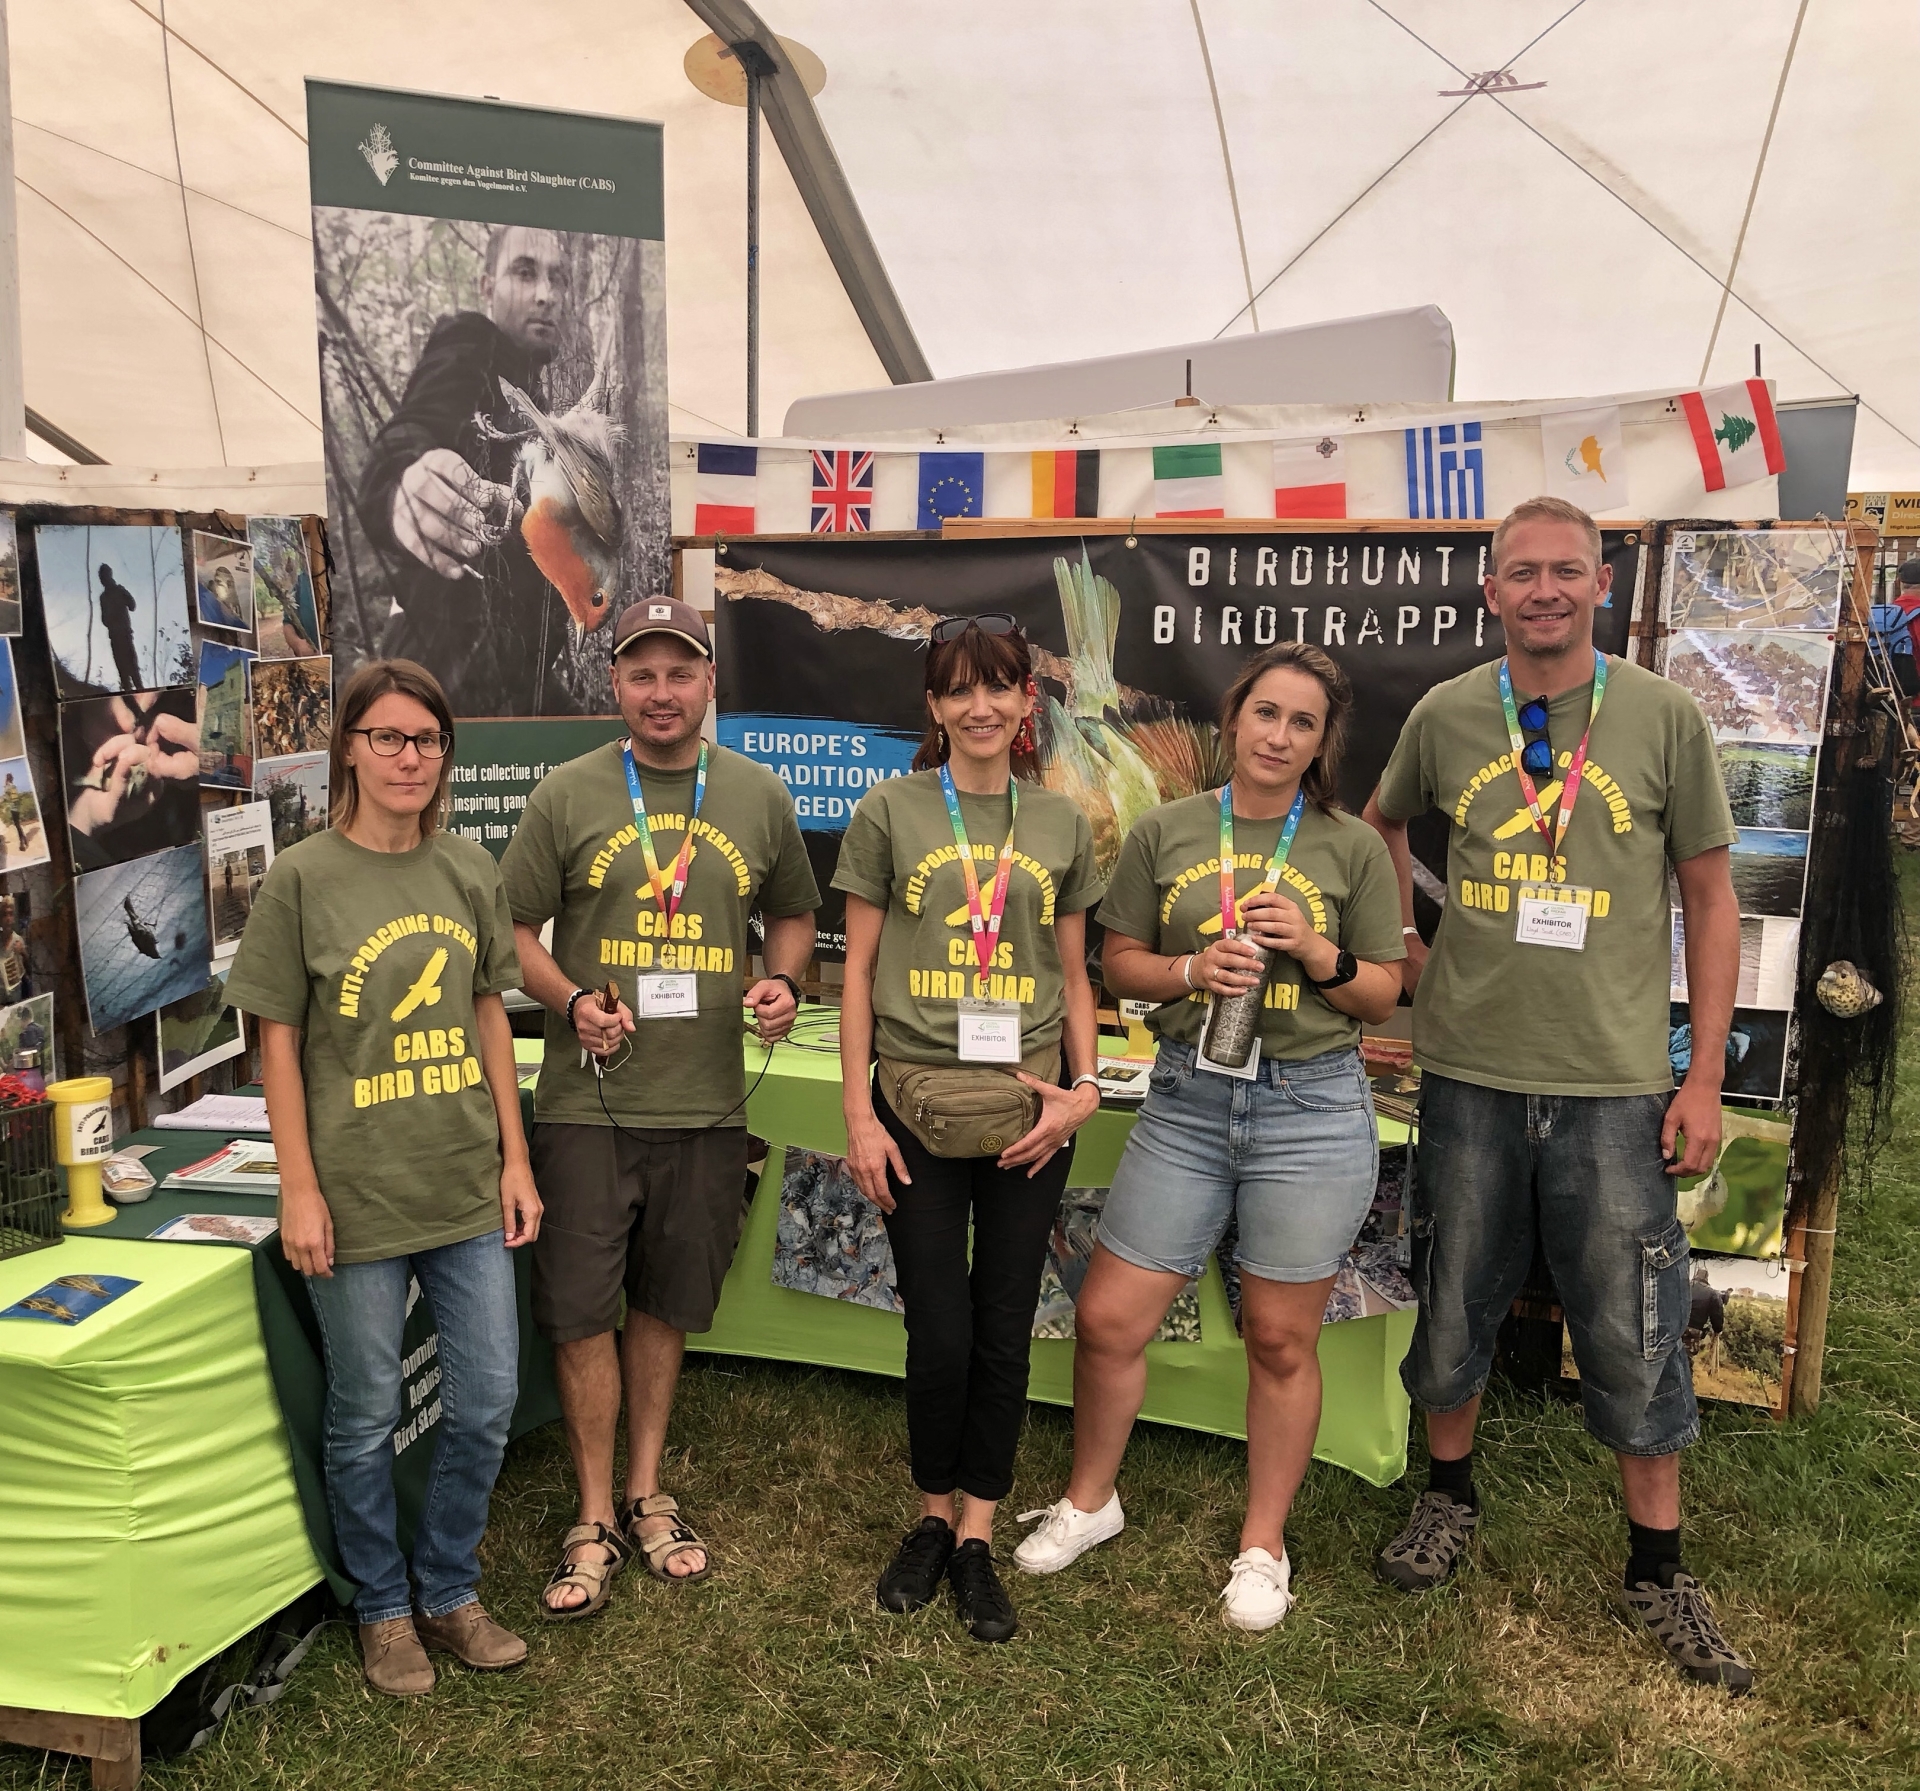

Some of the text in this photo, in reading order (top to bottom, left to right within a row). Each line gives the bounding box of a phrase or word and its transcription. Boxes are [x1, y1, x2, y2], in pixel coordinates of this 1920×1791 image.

[408, 157, 616, 193] Committee Against Bird Slaughter (CABS)
[409, 172, 528, 193] Komitee gegen den Vogelmord e.V.
[744, 732, 867, 757] EUROPE'S
[480, 763, 531, 782] collective
[533, 762, 545, 780] of
[761, 763, 914, 789] ADITIONA
[454, 793, 500, 815] inspiring
[459, 823, 482, 843] long
[484, 822, 508, 839] time
[588, 813, 751, 897] ANTI-POAHING OPERATIONS
[1493, 851, 1567, 883] CABS
[999, 849, 1056, 926] PERATIONS
[1161, 853, 1264, 926] ANTI-POACING
[1461, 880, 1510, 913] BIRD
[637, 910, 703, 940] CABS
[1532, 917, 1572, 928] EXHIBITOR
[339, 913, 478, 1019] ANTI-POACHING OPERA
[600, 938, 734, 973] BIRD GUARD
[650, 992, 685, 1000] EXHIBITOR
[909, 969, 965, 999] BIRD
[394, 1026, 466, 1063] CABS
[971, 1034, 1007, 1042] EXHIBITOR
[354, 1056, 482, 1109] BIRD GUD
[80, 1146, 99, 1156] BIRD
[401, 1332, 440, 1380] ommitt
[393, 1397, 443, 1456] Bird Slau
